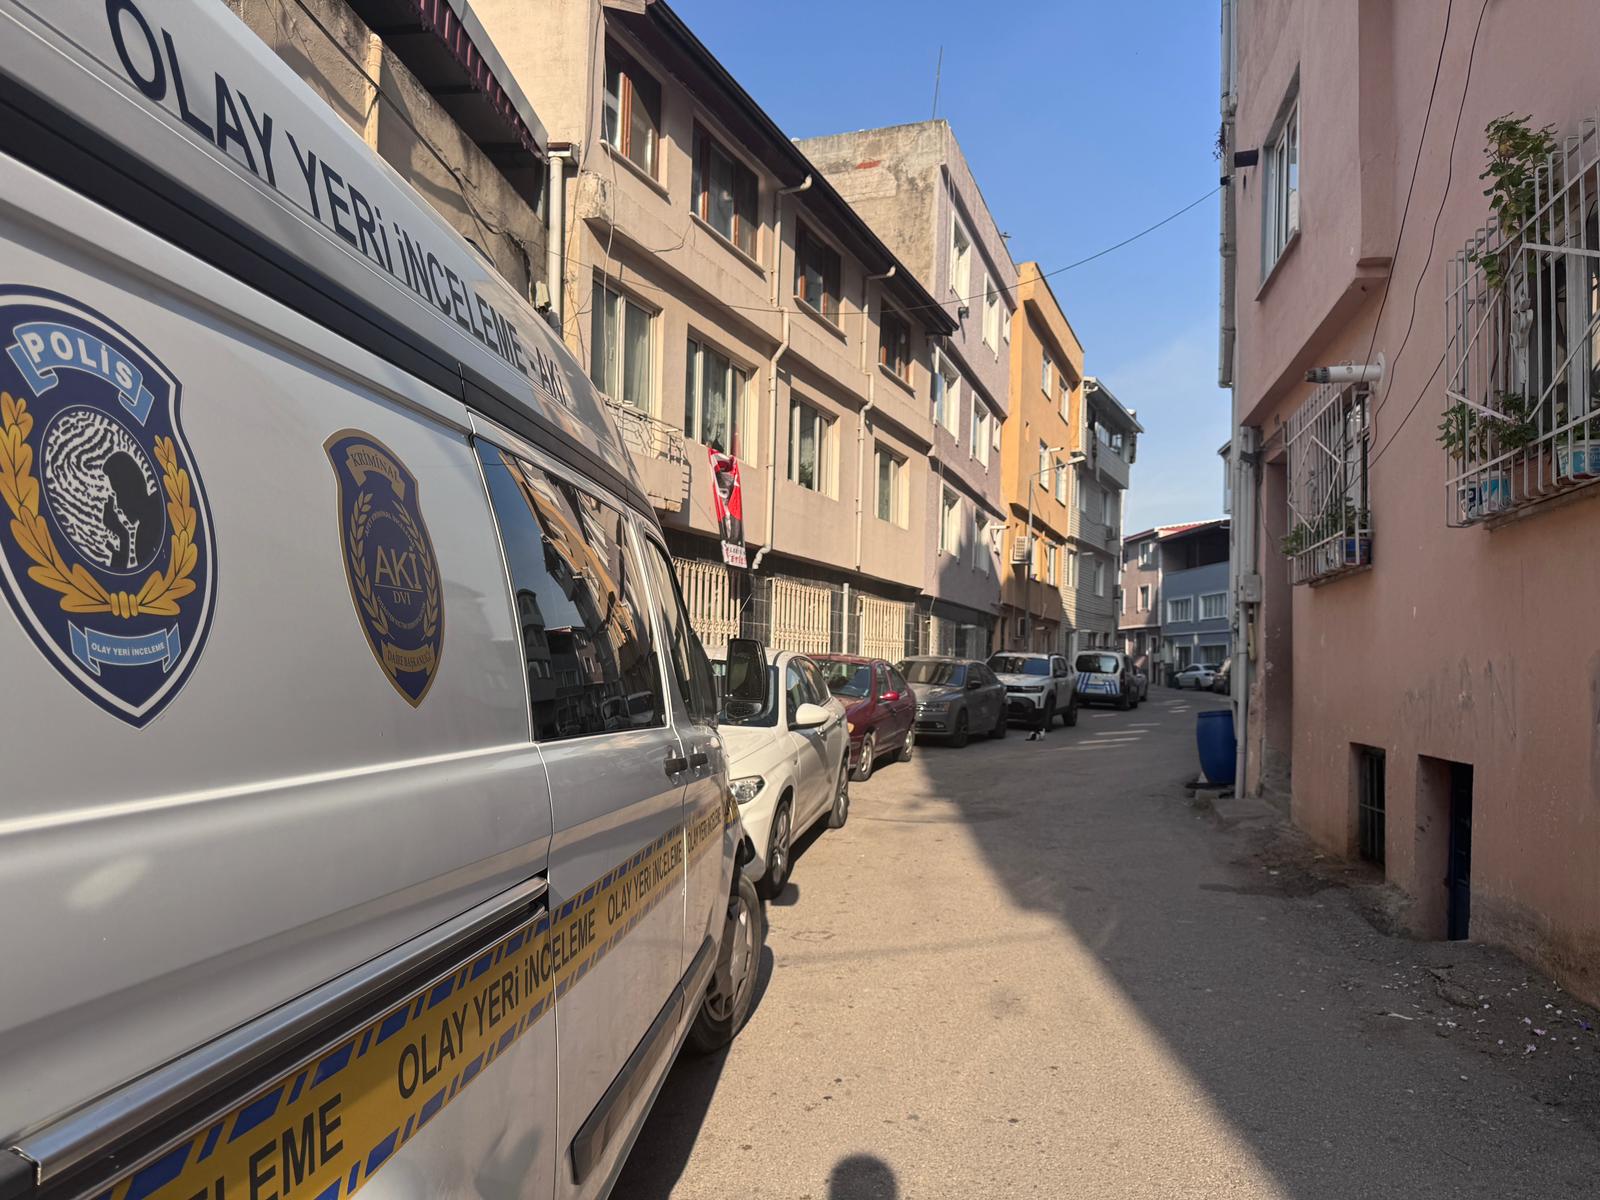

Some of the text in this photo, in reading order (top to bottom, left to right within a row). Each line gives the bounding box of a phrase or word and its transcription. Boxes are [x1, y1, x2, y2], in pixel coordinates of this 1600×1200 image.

[105, 0, 277, 189] OLAY
[21, 330, 134, 390] POLİS
[91, 643, 111, 654] OLAY
[607, 880, 633, 926] OLAY
[398, 1002, 468, 1099] OLAY
